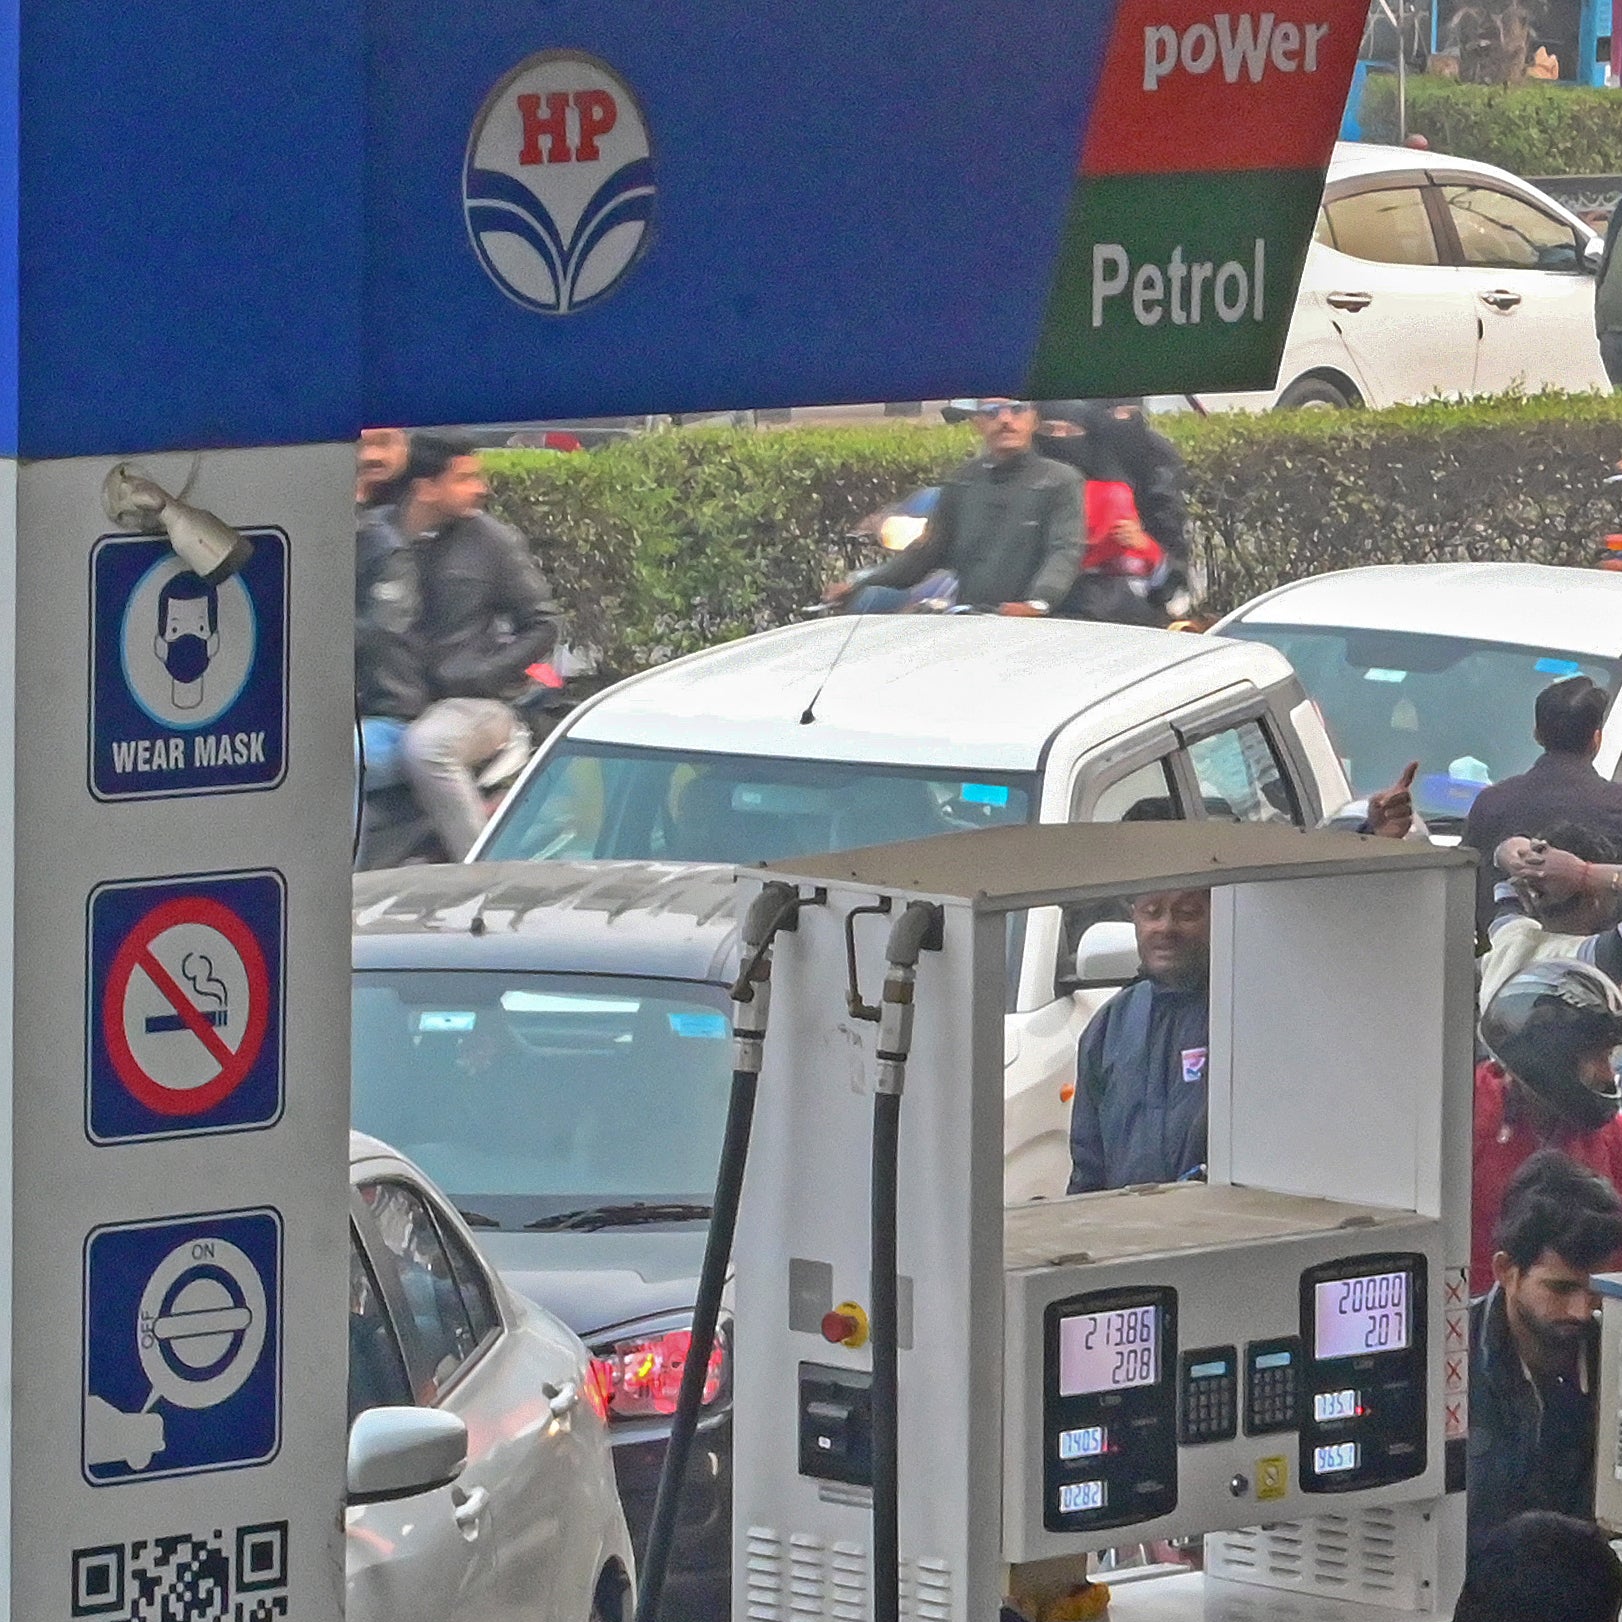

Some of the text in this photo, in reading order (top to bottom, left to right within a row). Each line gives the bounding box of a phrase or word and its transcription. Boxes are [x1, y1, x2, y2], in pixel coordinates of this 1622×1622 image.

[517, 89, 617, 165] HP
[1092, 238, 1265, 327] Petrol
[112, 731, 265, 774] WEAR MASK
[191, 1243, 215, 1260] ON
[141, 1310, 155, 1350] OFF
